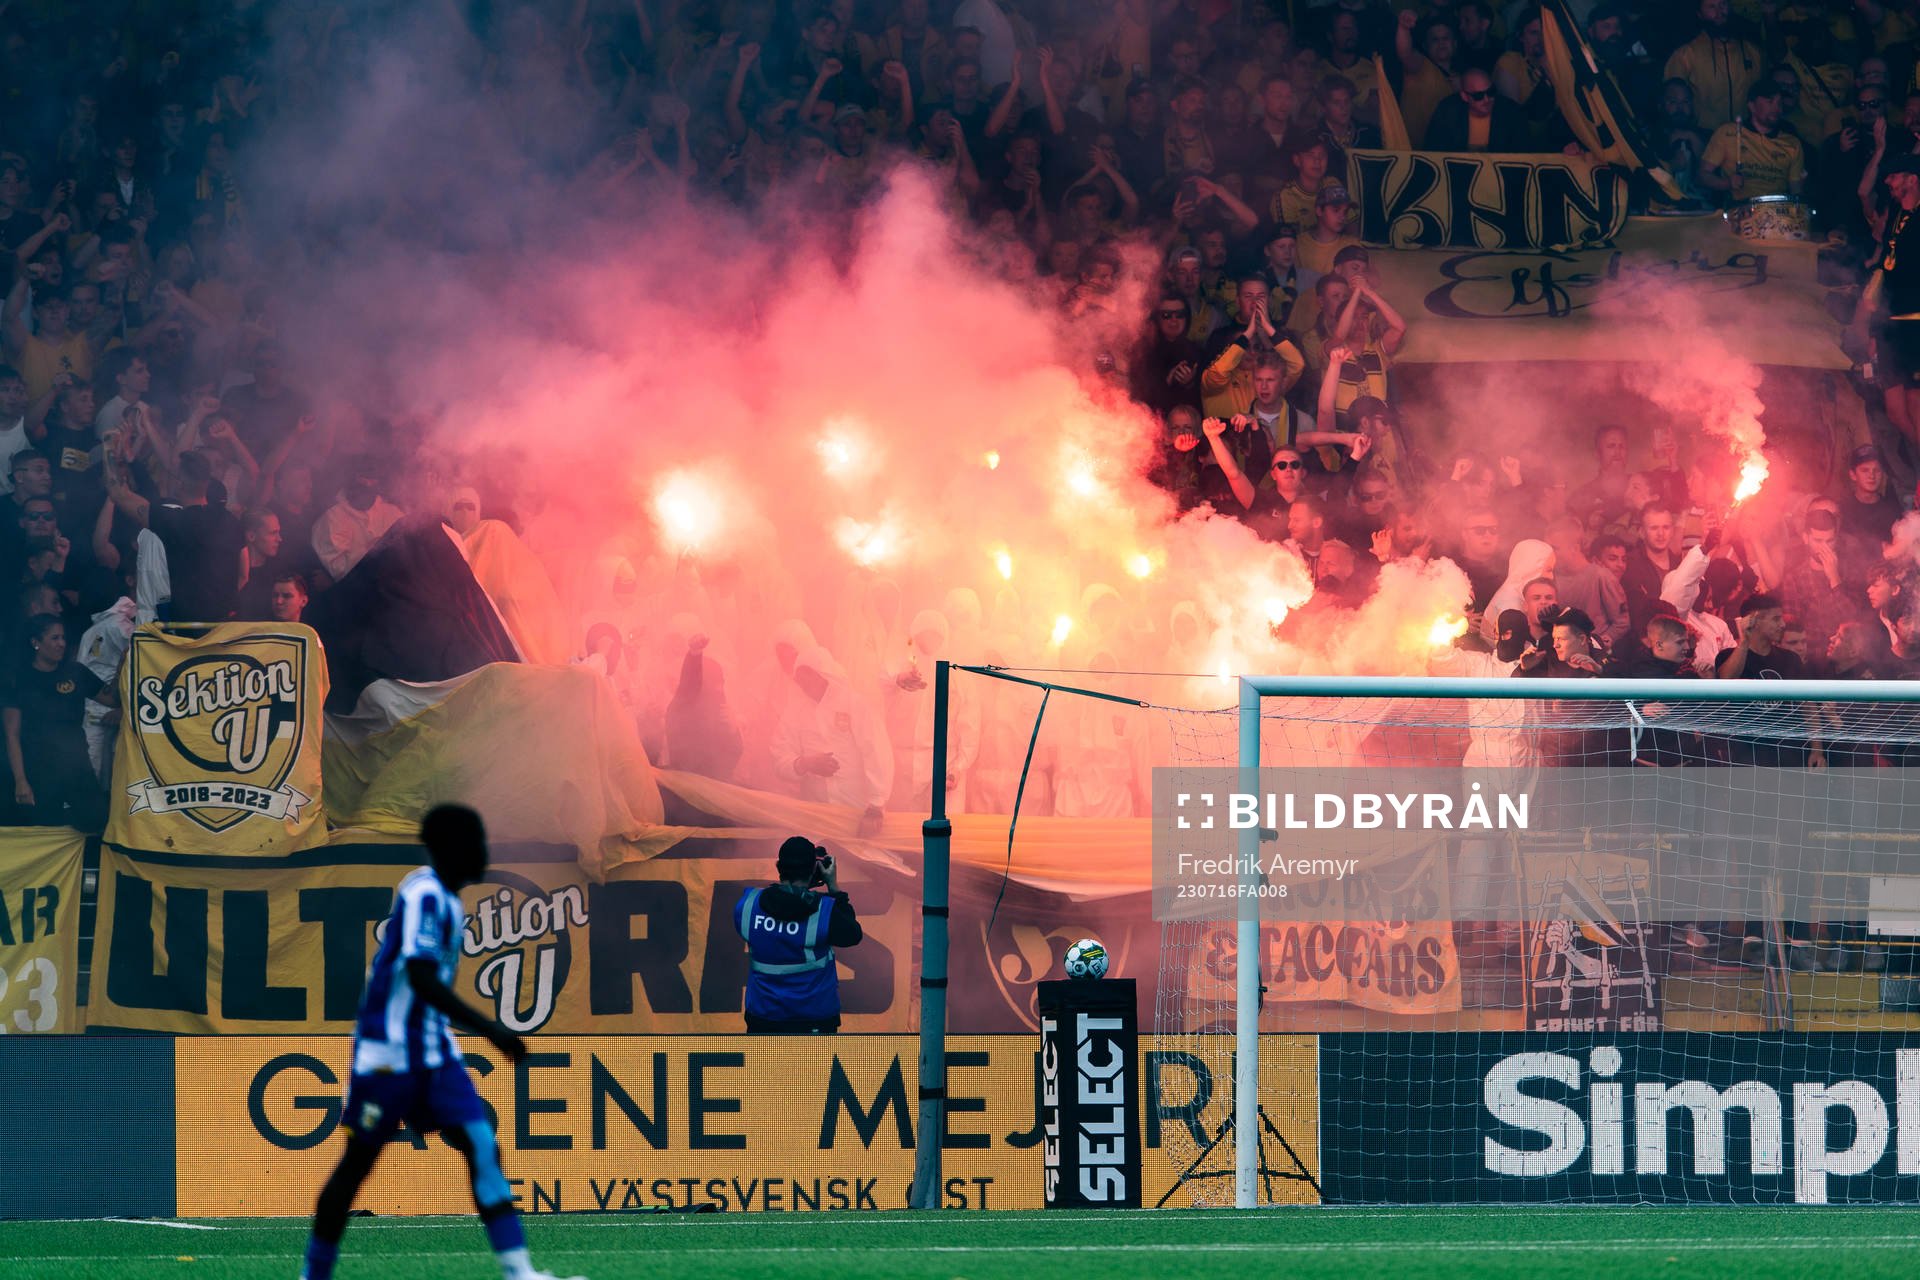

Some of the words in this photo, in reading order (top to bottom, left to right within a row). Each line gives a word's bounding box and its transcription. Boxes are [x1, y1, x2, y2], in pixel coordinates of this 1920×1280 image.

[1352, 153, 1625, 250] KHN
[138, 660, 295, 727] Sektion
[213, 705, 270, 772] U
[164, 786, 272, 810] 2018-2023
[0, 884, 60, 946] R
[0, 957, 58, 1033] 3
[478, 947, 556, 1032] U
[248, 1052, 748, 1150] GENE
[818, 1050, 1238, 1150] MEJR
[1042, 1016, 1058, 1202] SELECT
[1077, 1013, 1126, 1202] SELECT
[589, 1177, 878, 1211] VÄSTSVENSK
[905, 1177, 993, 1210] ST
